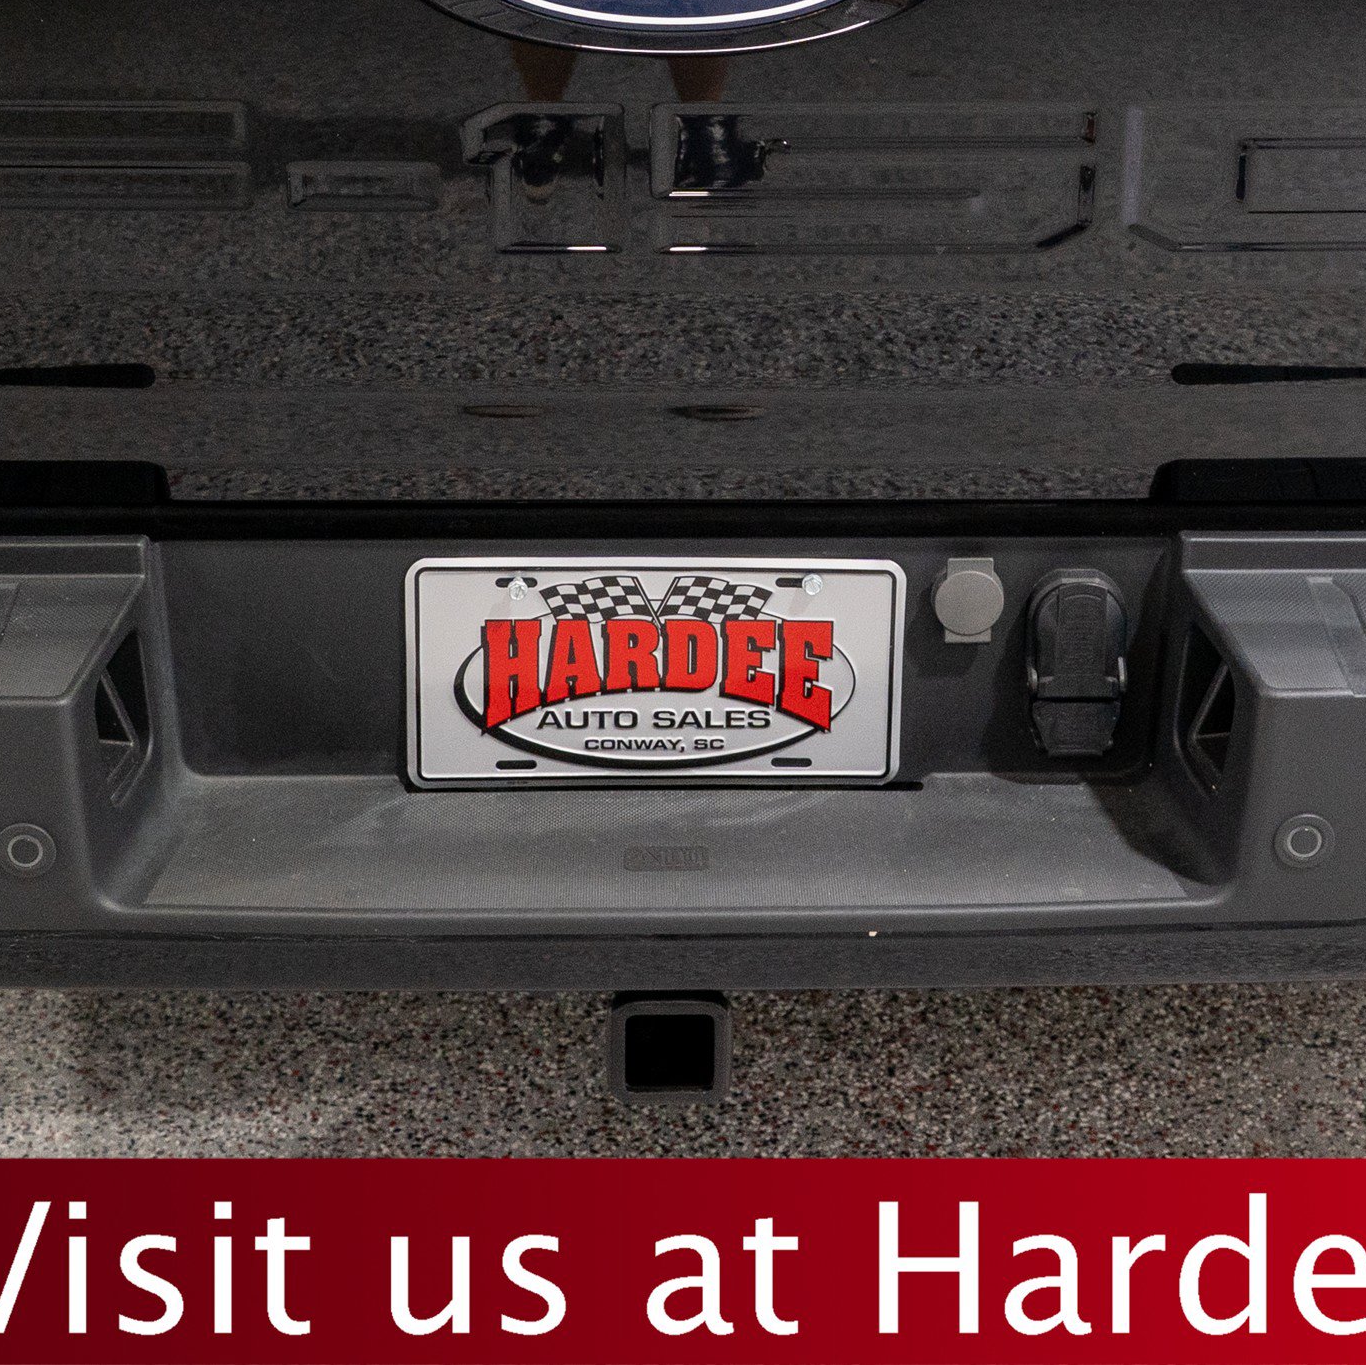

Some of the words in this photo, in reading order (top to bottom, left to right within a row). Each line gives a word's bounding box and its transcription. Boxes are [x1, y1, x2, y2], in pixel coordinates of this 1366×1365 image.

[481, 618, 834, 735] HARDEE
[536, 709, 640, 730] AUTO
[651, 708, 772, 730] SALES
[583, 736, 687, 754] CONWAY,
[693, 736, 726, 751] SC
